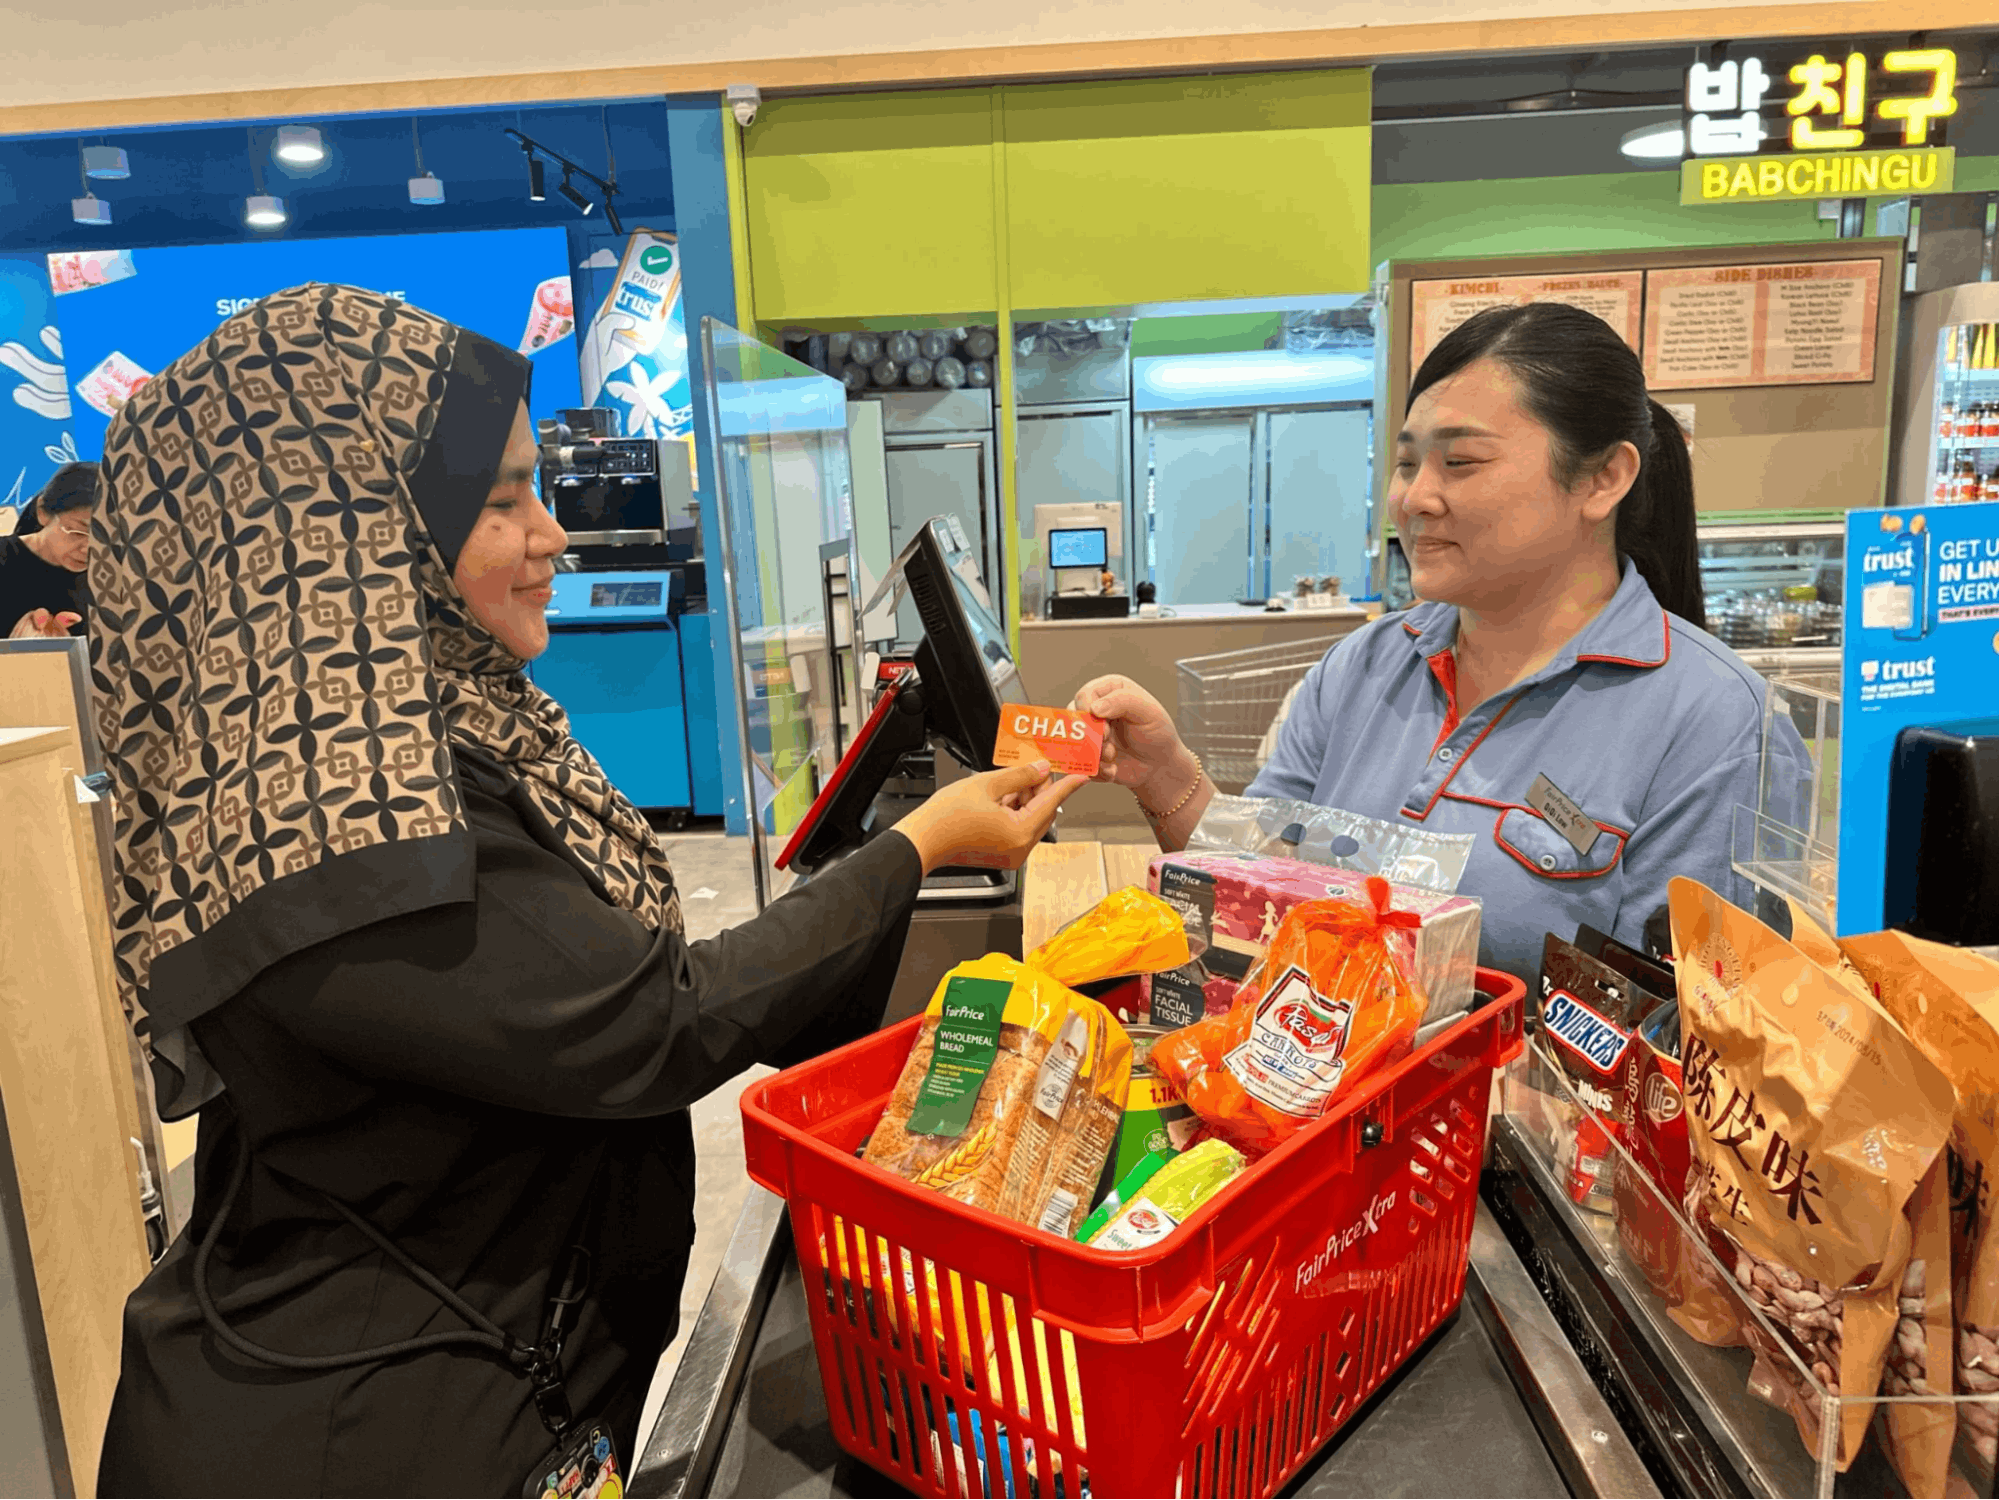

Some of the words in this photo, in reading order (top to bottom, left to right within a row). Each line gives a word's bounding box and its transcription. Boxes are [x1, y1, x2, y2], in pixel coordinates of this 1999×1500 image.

[1702, 153, 1938, 198] BABCHINGU
[631, 271, 664, 291] PAID!
[1714, 269, 1751, 282] SIDE
[1756, 266, 1814, 280] DISHES
[1450, 282, 1499, 295] KIMCHI
[1863, 547, 1914, 572] trust
[1939, 539, 1981, 560] GET
[1939, 562, 1961, 582] IN
[1938, 583, 1999, 604] EVERY
[1882, 656, 1935, 680] trust
[1014, 714, 1087, 740] CHAS
[1165, 869, 1201, 885] FairPrice
[1155, 994, 1193, 1016] FACIAL
[1155, 1005, 1192, 1026] TISSUE
[940, 1030, 994, 1047] WHOLEMEAL
[1544, 997, 1626, 1067] SNICKERS
[940, 1041, 965, 1053] BREAD
[1261, 1033, 1317, 1069] CARROTS
[1578, 1079, 1613, 1112] MINIS
[1649, 1078, 1677, 1118] life
